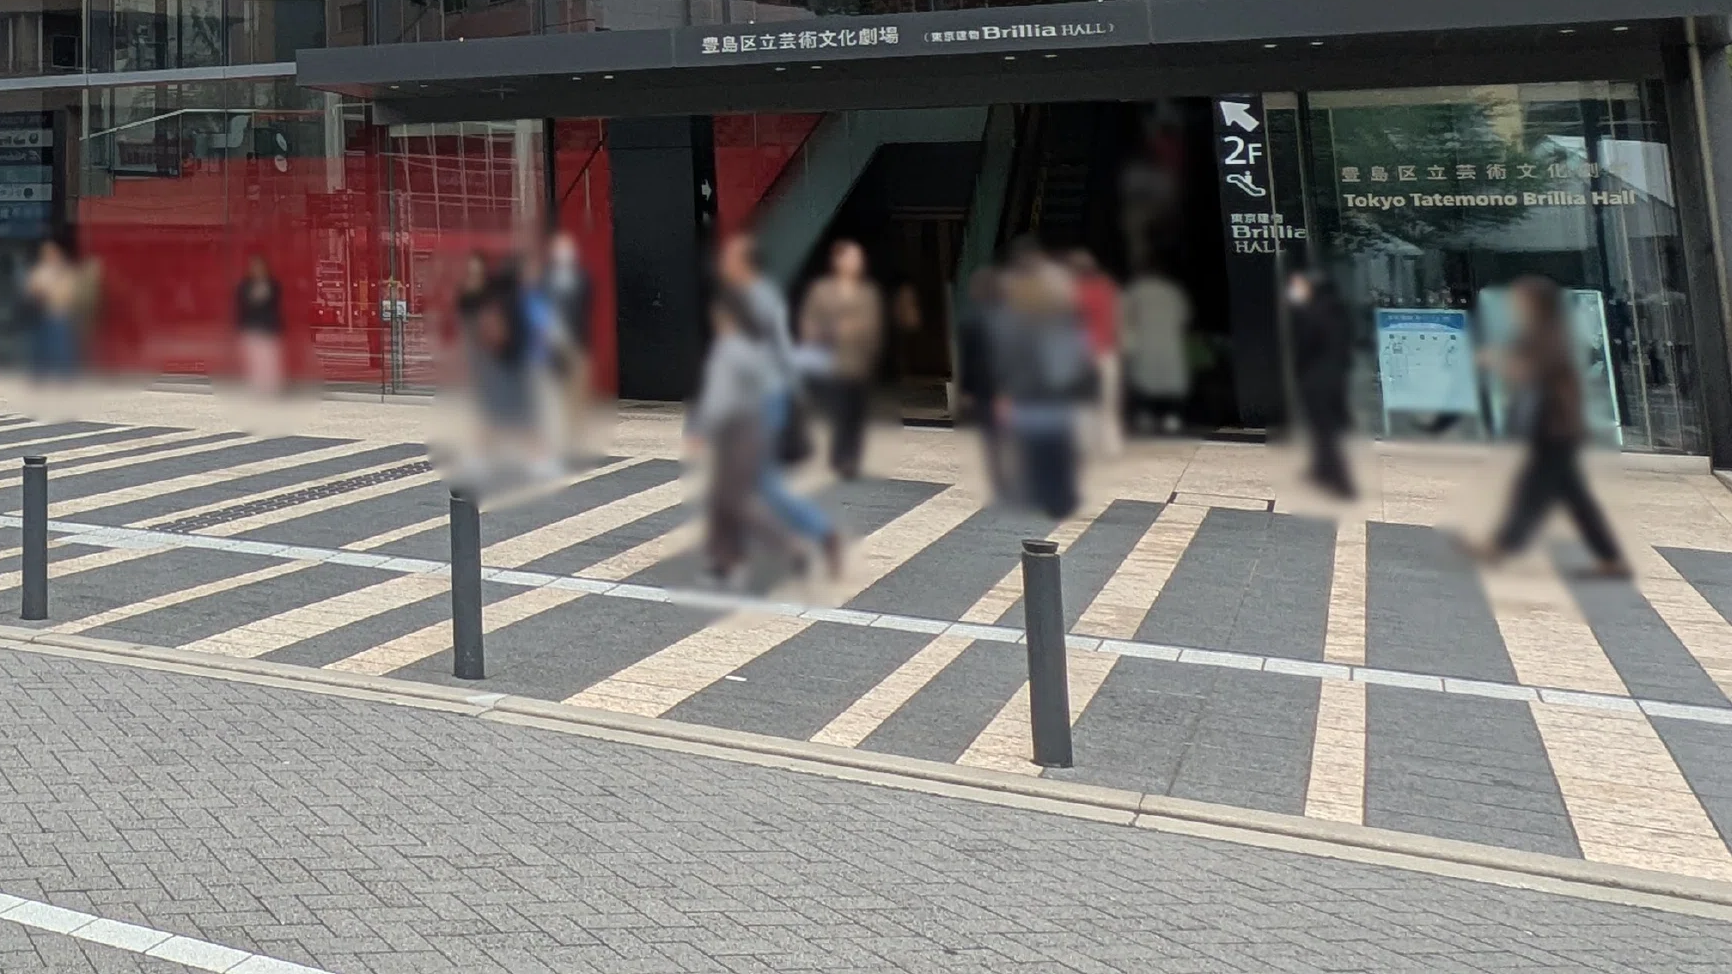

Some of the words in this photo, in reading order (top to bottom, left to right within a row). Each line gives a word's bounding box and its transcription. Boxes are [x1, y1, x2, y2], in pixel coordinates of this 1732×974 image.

[701, 26, 899, 54] 豊島区立芸術文化劇場
[982, 24, 1057, 40] Brillia
[1223, 135, 1263, 165] 2F
[1343, 193, 1406, 211] Tokyo
[1409, 192, 1518, 207] Tatemono
[1523, 190, 1586, 206] Brillia
[1591, 189, 1637, 205] Hall
[1231, 225, 1307, 239] Brillia
